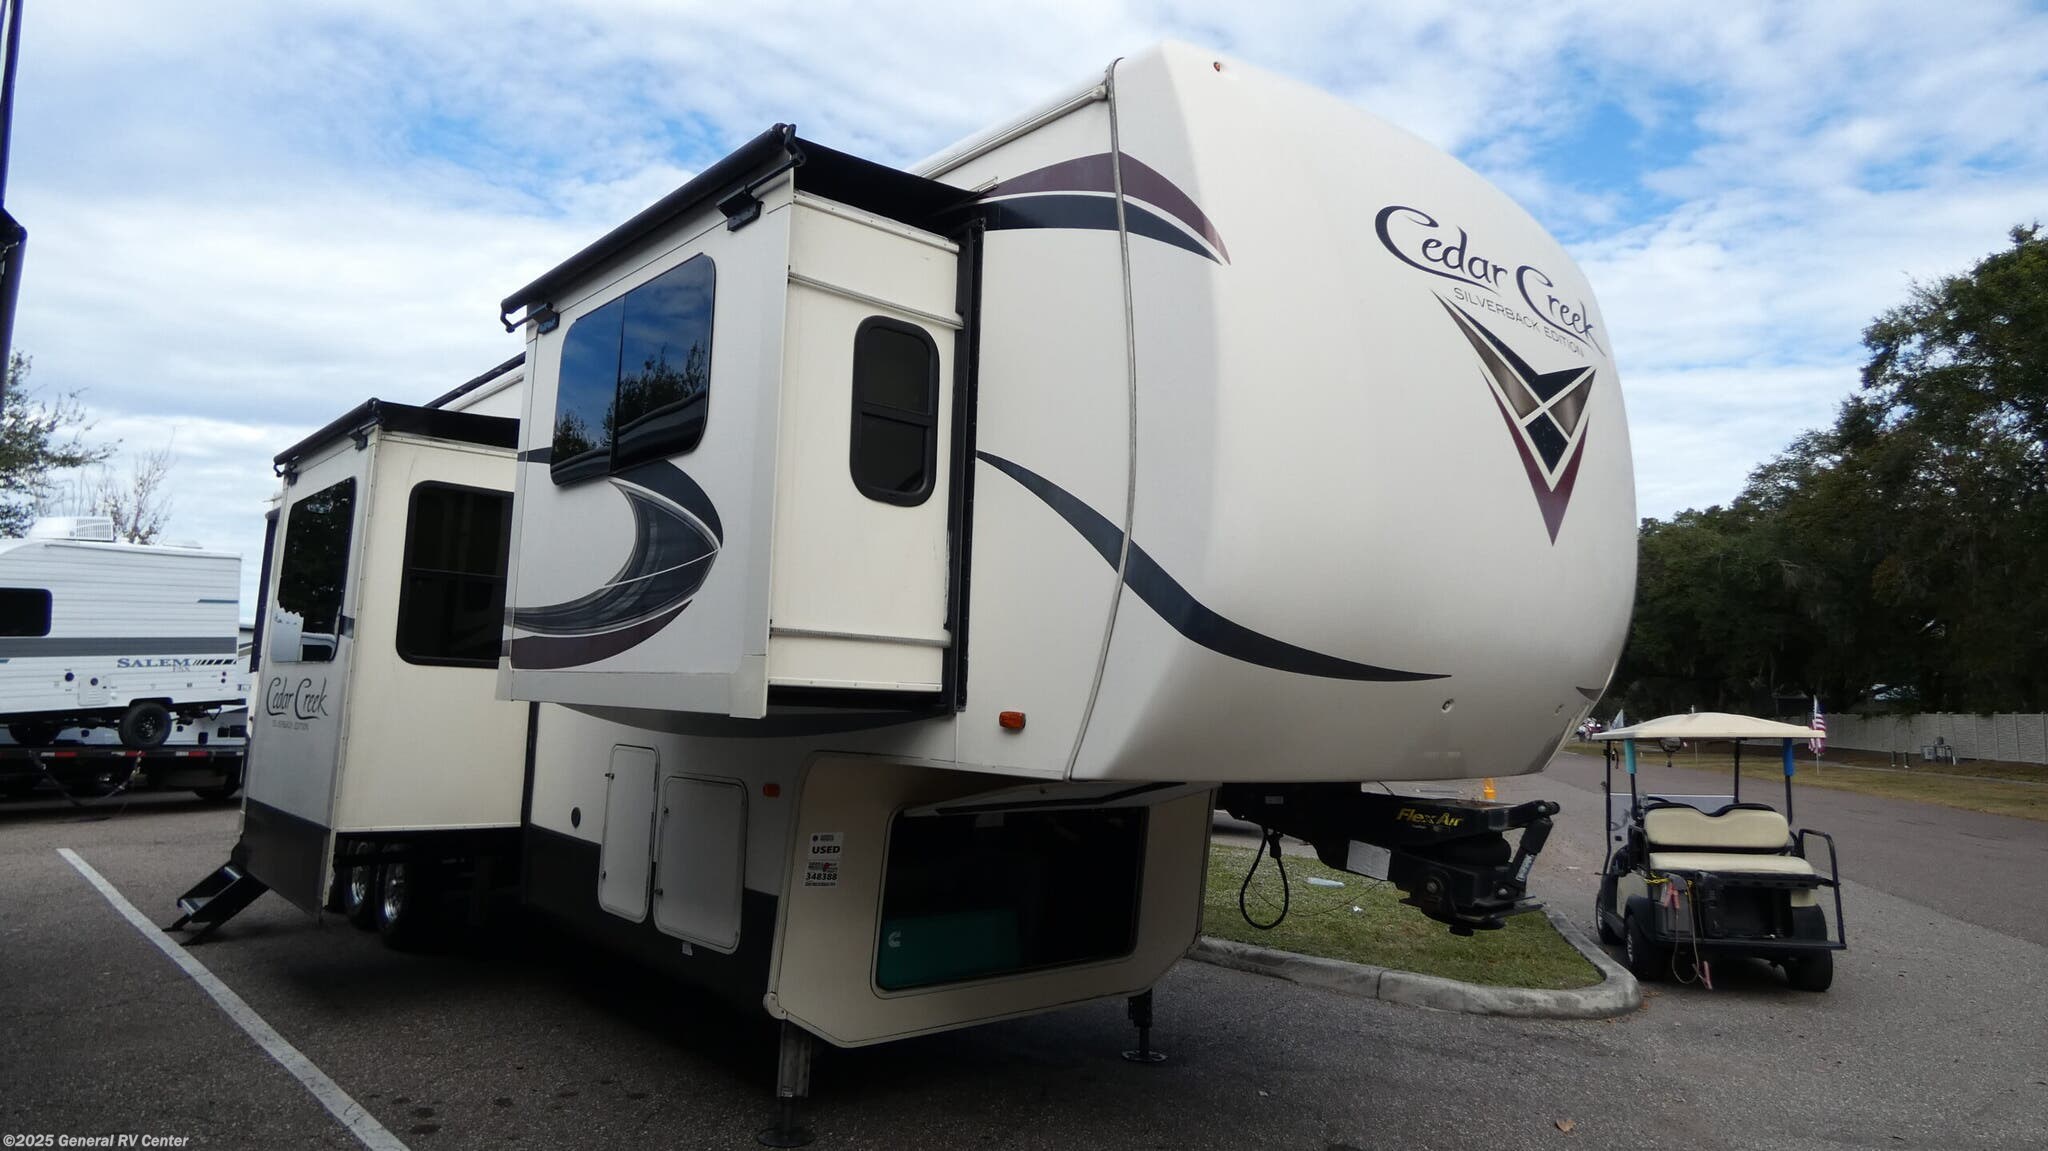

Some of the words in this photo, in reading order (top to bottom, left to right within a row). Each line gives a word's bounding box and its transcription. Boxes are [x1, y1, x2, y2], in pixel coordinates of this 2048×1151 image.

[1374, 205, 1508, 297] Cedar
[1515, 265, 1607, 358] Creek
[1453, 287, 1541, 333] SILVERBACK
[1543, 326, 1585, 358] EDITION
[117, 657, 191, 668] SALEM
[266, 676, 294, 717] Cedar
[295, 677, 329, 720] Creek
[812, 845, 840, 854] USED
[806, 872, 838, 881] 348388
